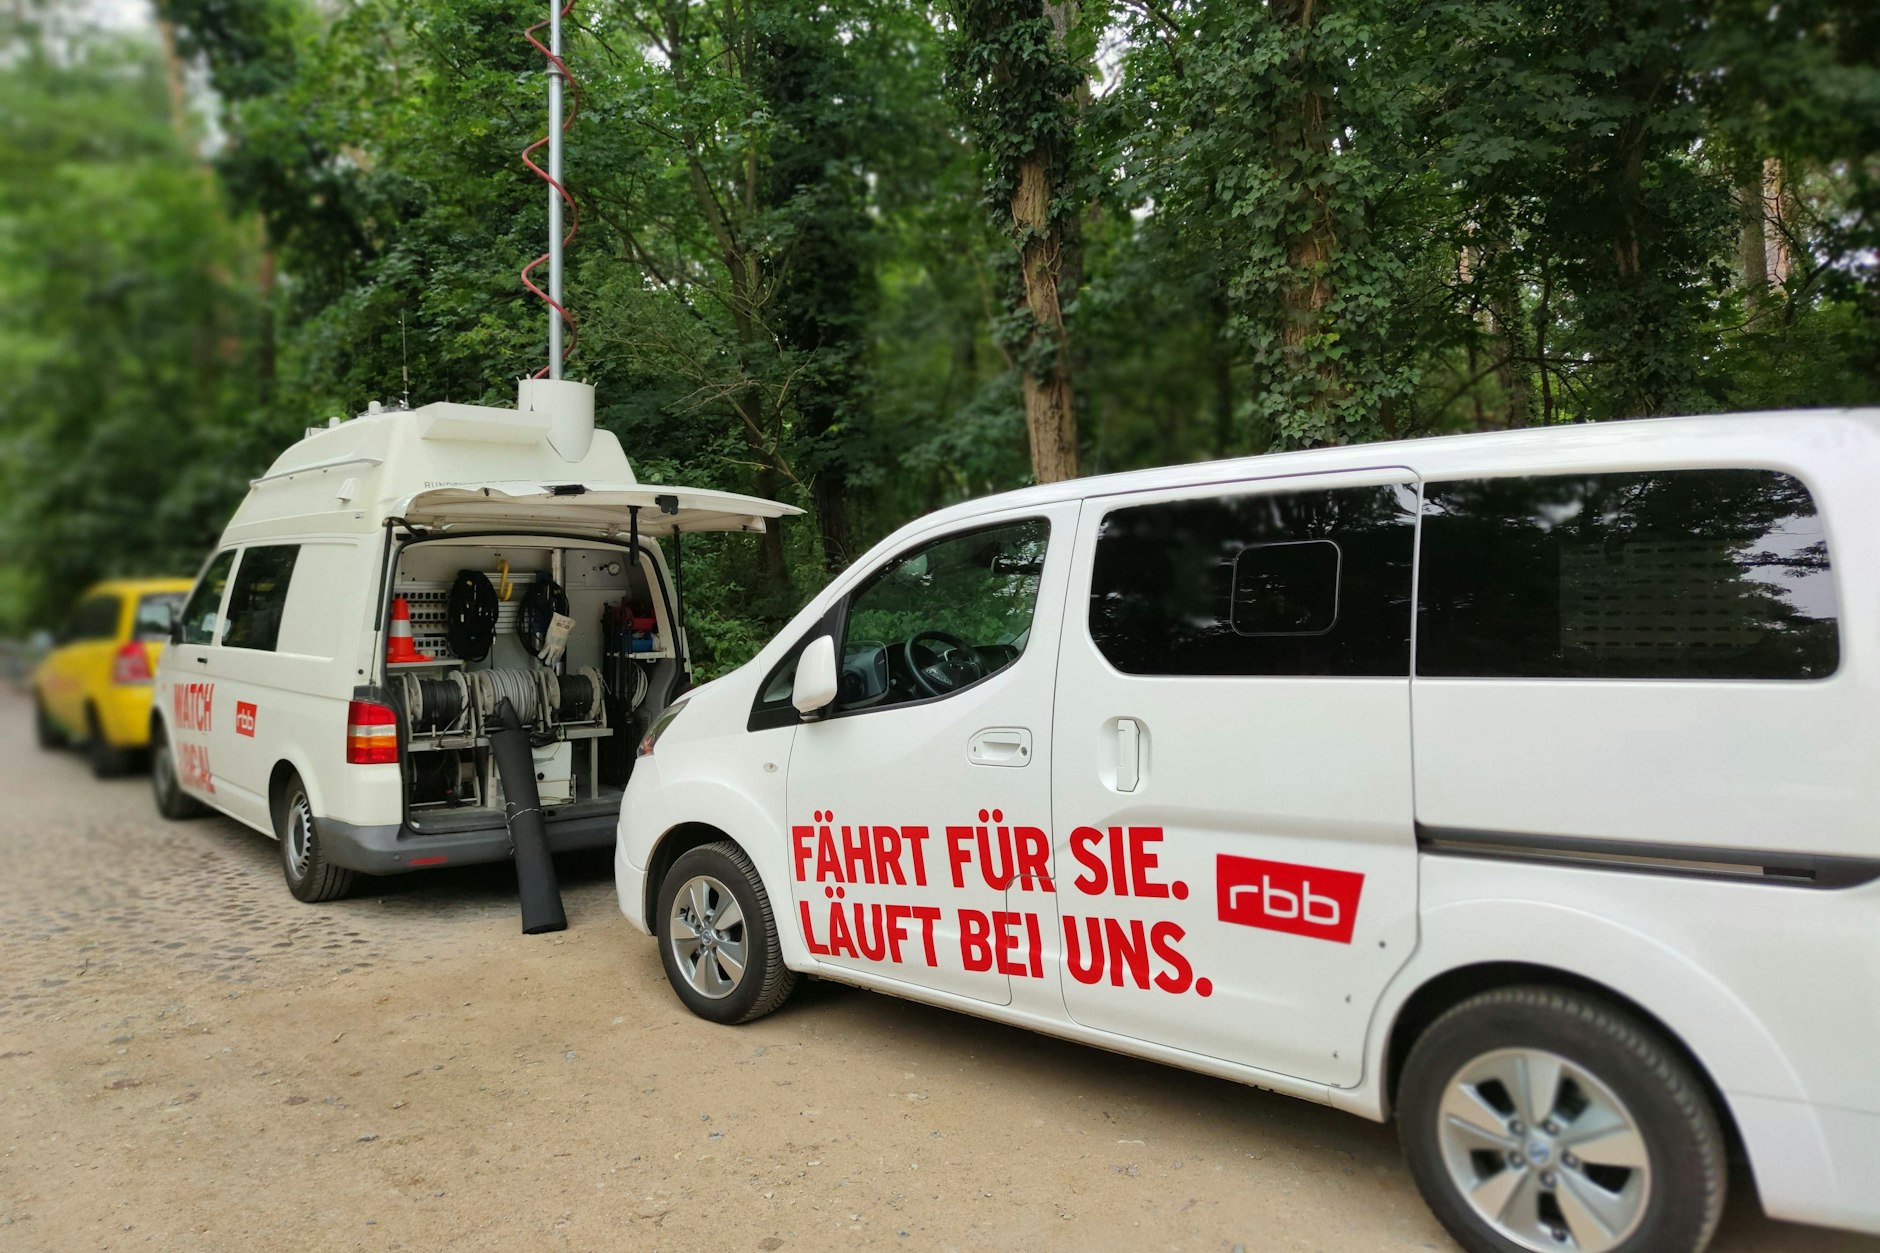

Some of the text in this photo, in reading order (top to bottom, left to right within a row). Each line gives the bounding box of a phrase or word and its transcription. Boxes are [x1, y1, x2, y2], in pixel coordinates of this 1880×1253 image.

[174, 683, 214, 731] WATCH
[791, 808, 1191, 901] FÄHRT FÜR SIE.
[1228, 873, 1342, 927] rbb
[799, 885, 1214, 998] LÄUFT BEI UNS.
